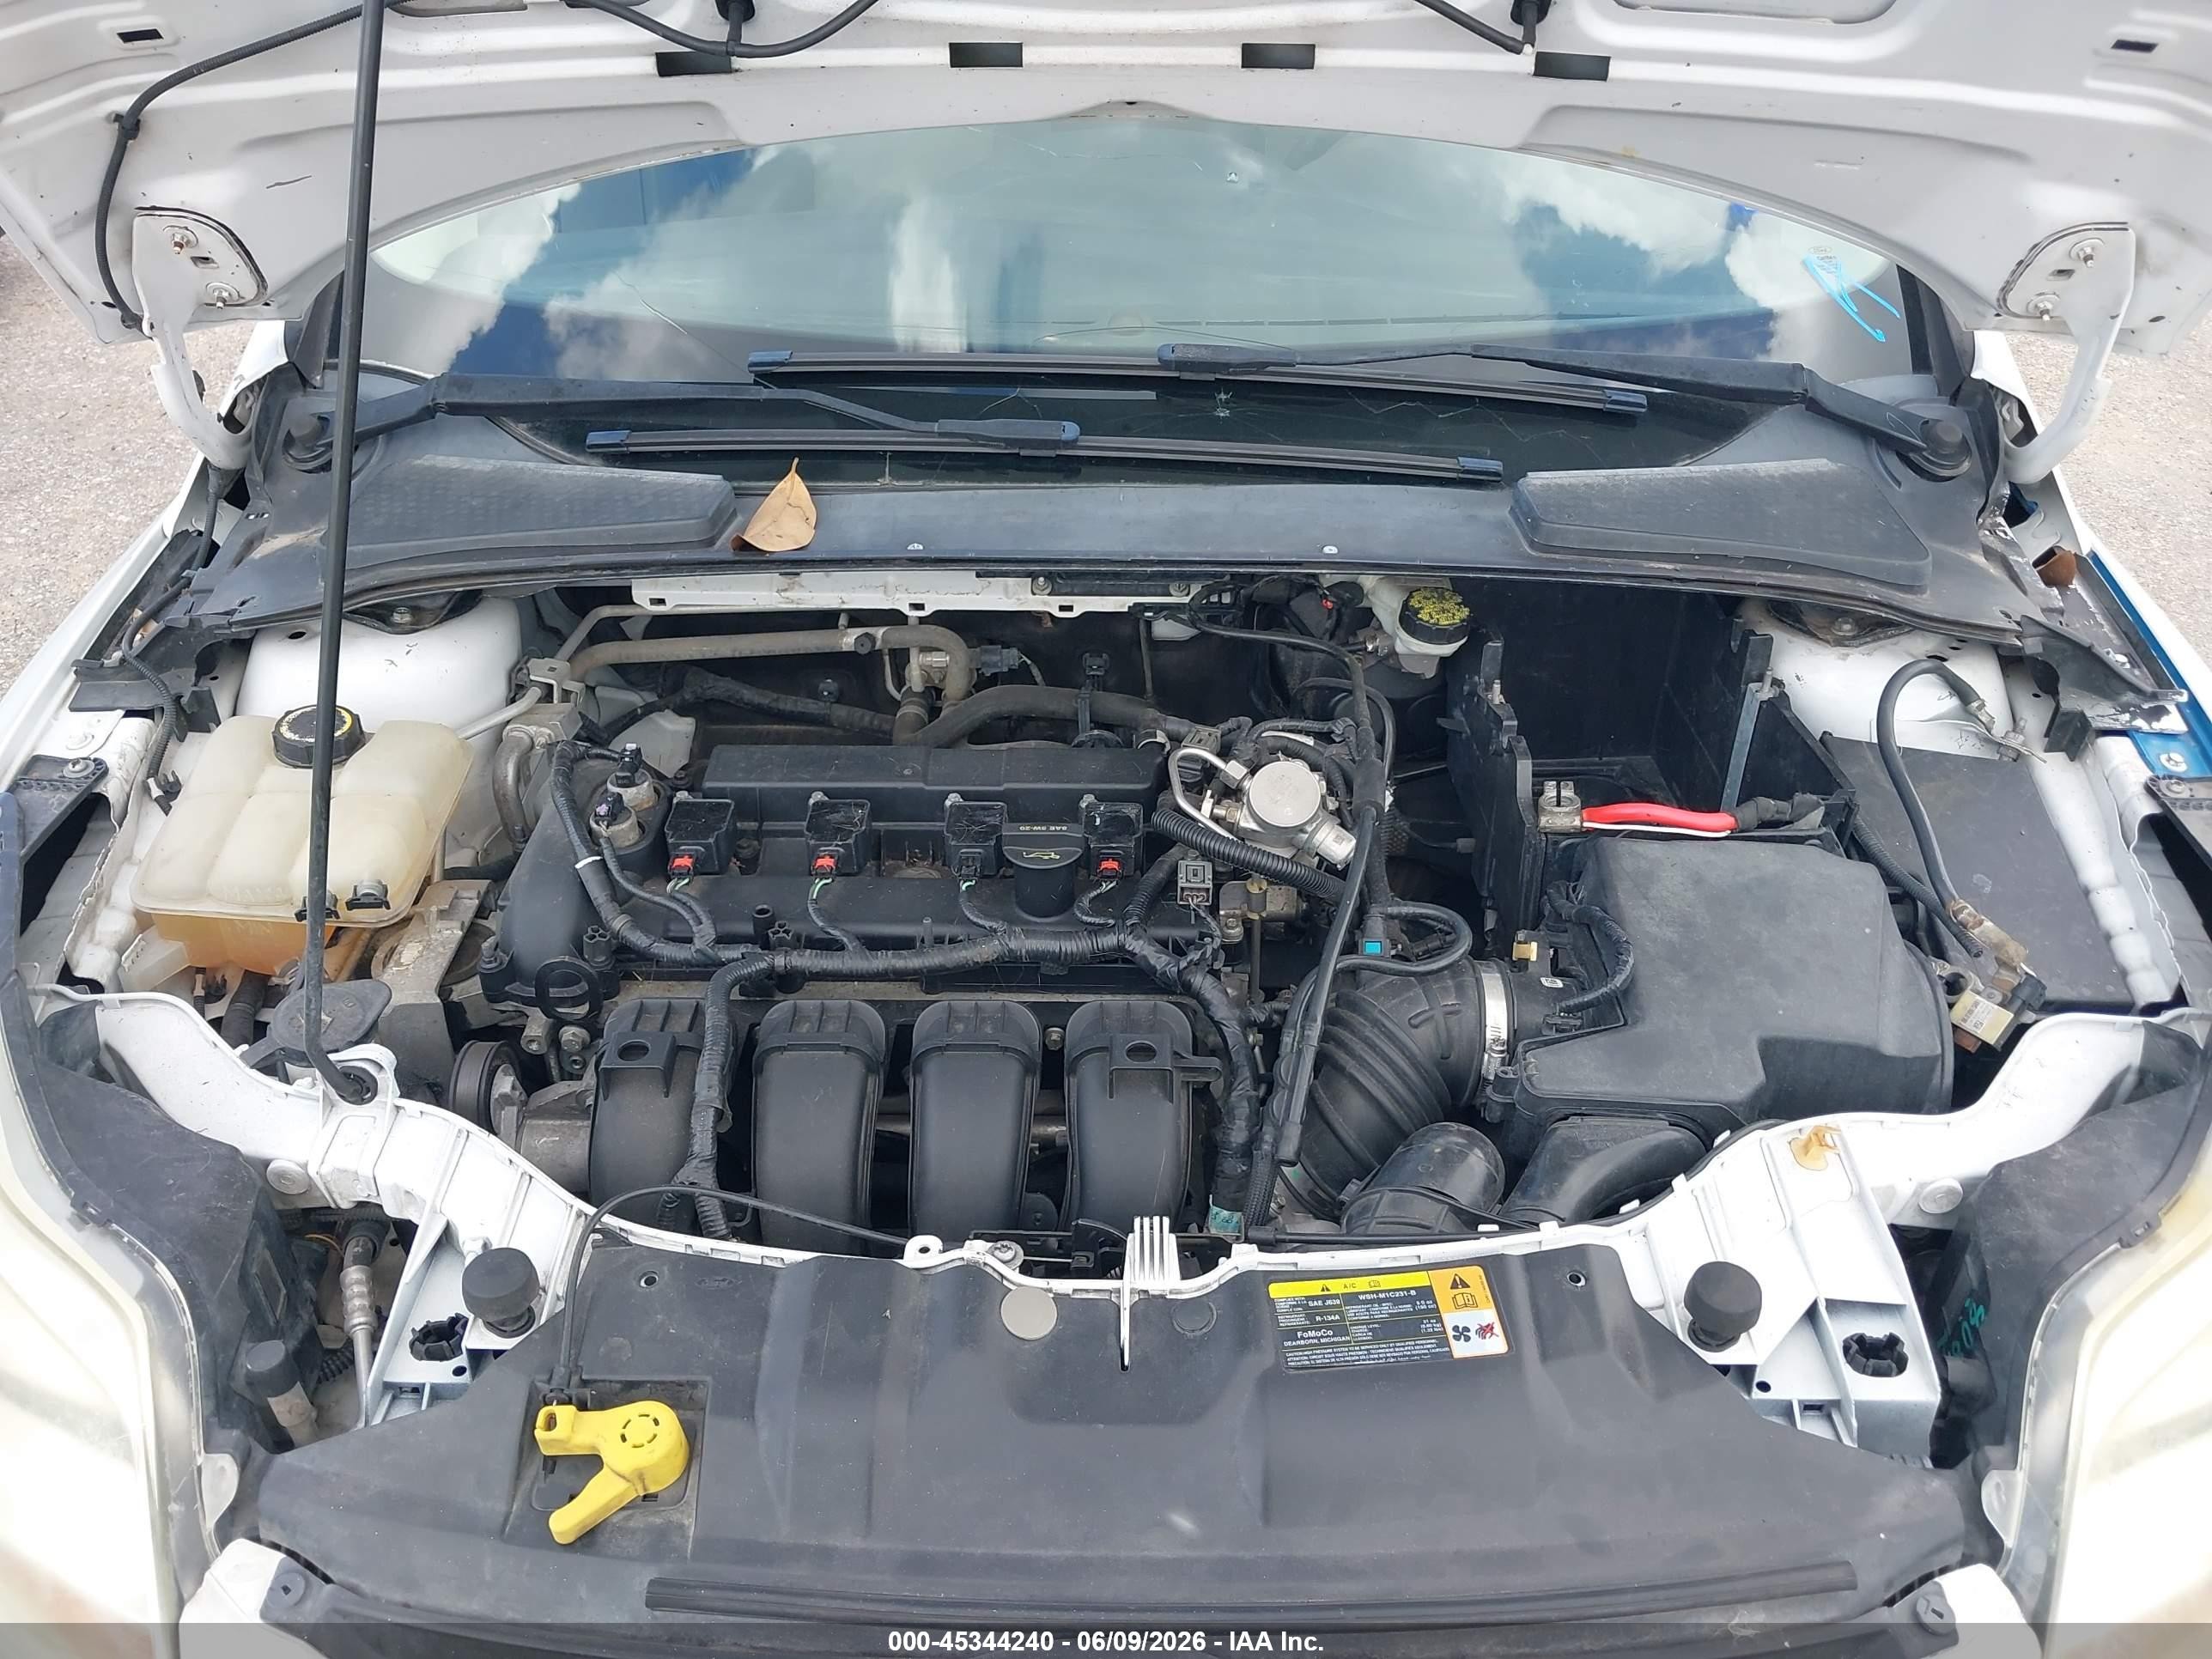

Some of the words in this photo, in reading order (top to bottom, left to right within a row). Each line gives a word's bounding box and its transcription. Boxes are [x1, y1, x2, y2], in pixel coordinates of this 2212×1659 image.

[1358, 1290, 1417, 1300] WSH-M1C231-B
[1315, 1314, 1340, 1322] R-134A
[1297, 1328, 1334, 1339] FoMoCo
